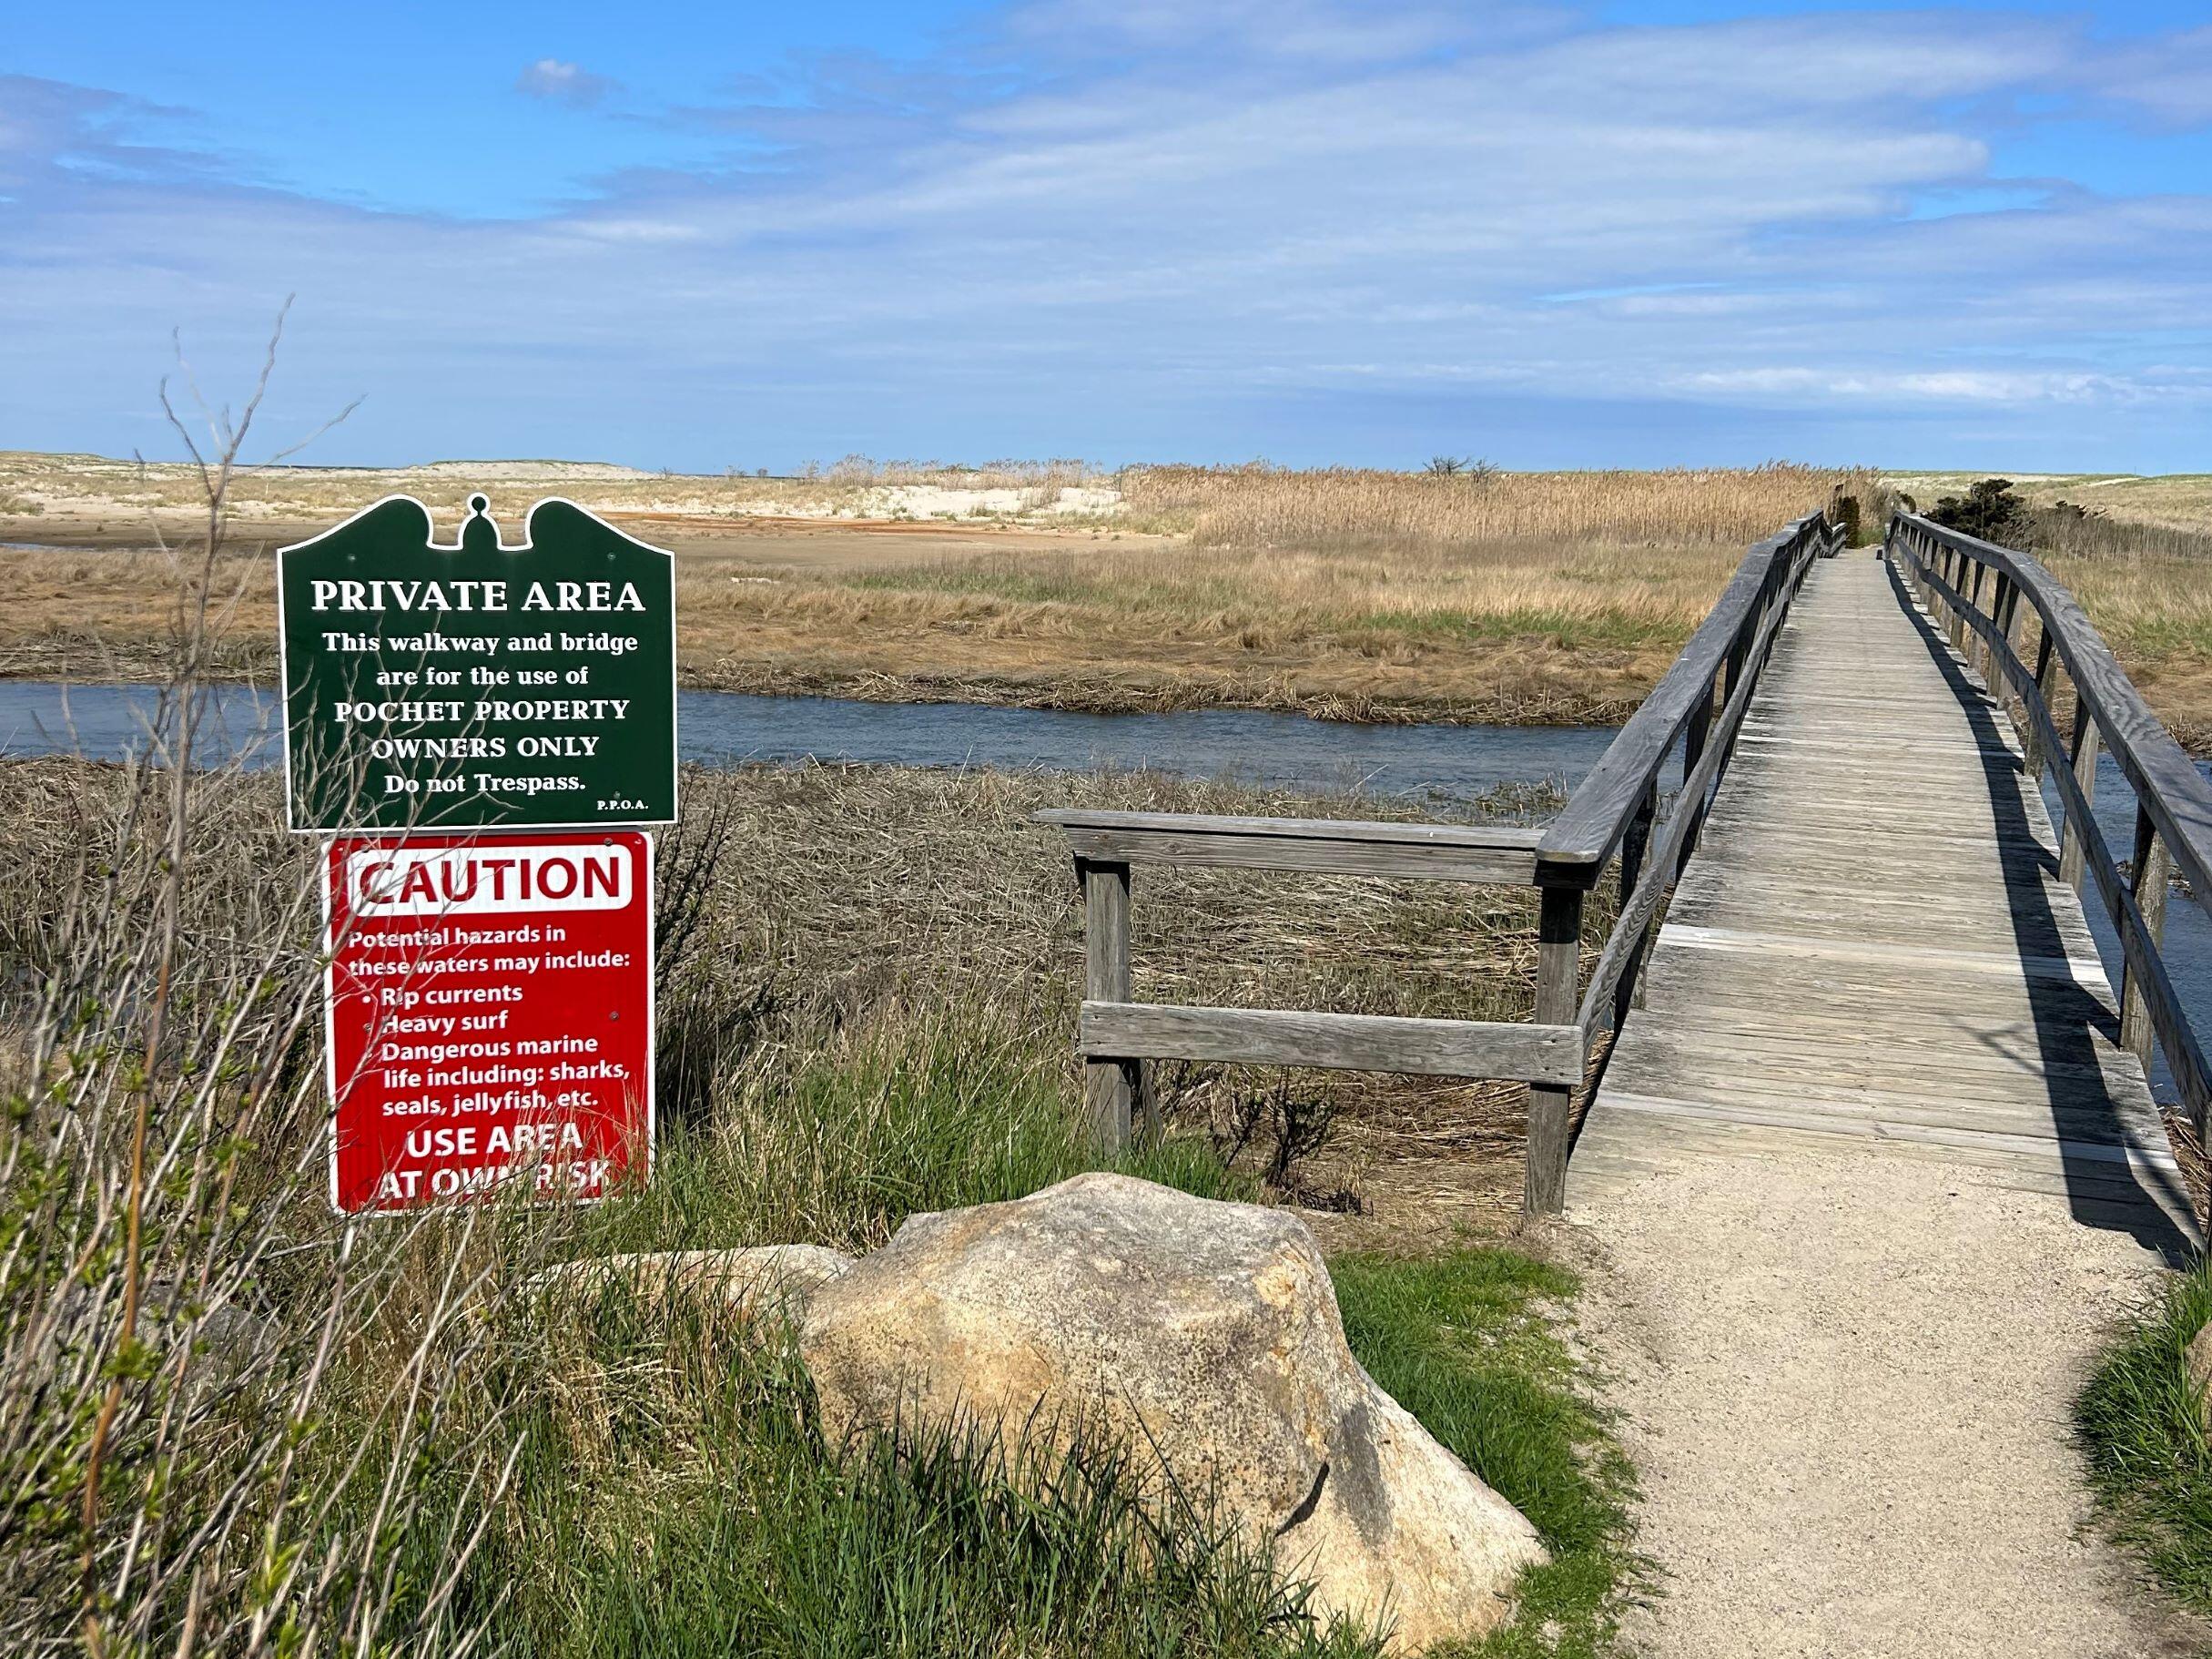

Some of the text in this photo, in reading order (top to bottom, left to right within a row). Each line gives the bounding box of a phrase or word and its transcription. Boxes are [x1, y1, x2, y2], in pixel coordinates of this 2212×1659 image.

[310, 580, 645, 611] PRIVATE AREA
[322, 632, 638, 656] This walkway and bridge
[376, 667, 589, 686] are for the use of
[334, 700, 630, 722] POCHET PROPERTY
[371, 737, 599, 759] OWNERS ONLY
[384, 774, 586, 795] Do not Trespass.
[597, 800, 648, 810] P.P.O.A.
[360, 857, 620, 905] CAUTION
[349, 925, 566, 948] Potential hazards in
[349, 951, 630, 976] these waters may include:
[381, 985, 523, 1010] Rip currents
[382, 1011, 509, 1037] Heavy surf
[382, 1036, 598, 1065] Dangerous marine
[384, 1061, 630, 1088] life including: sharks,
[383, 1090, 598, 1117] seals, jellyfish, etc.
[406, 1123, 583, 1158] USE AREA
[380, 1171, 421, 1200] AT
